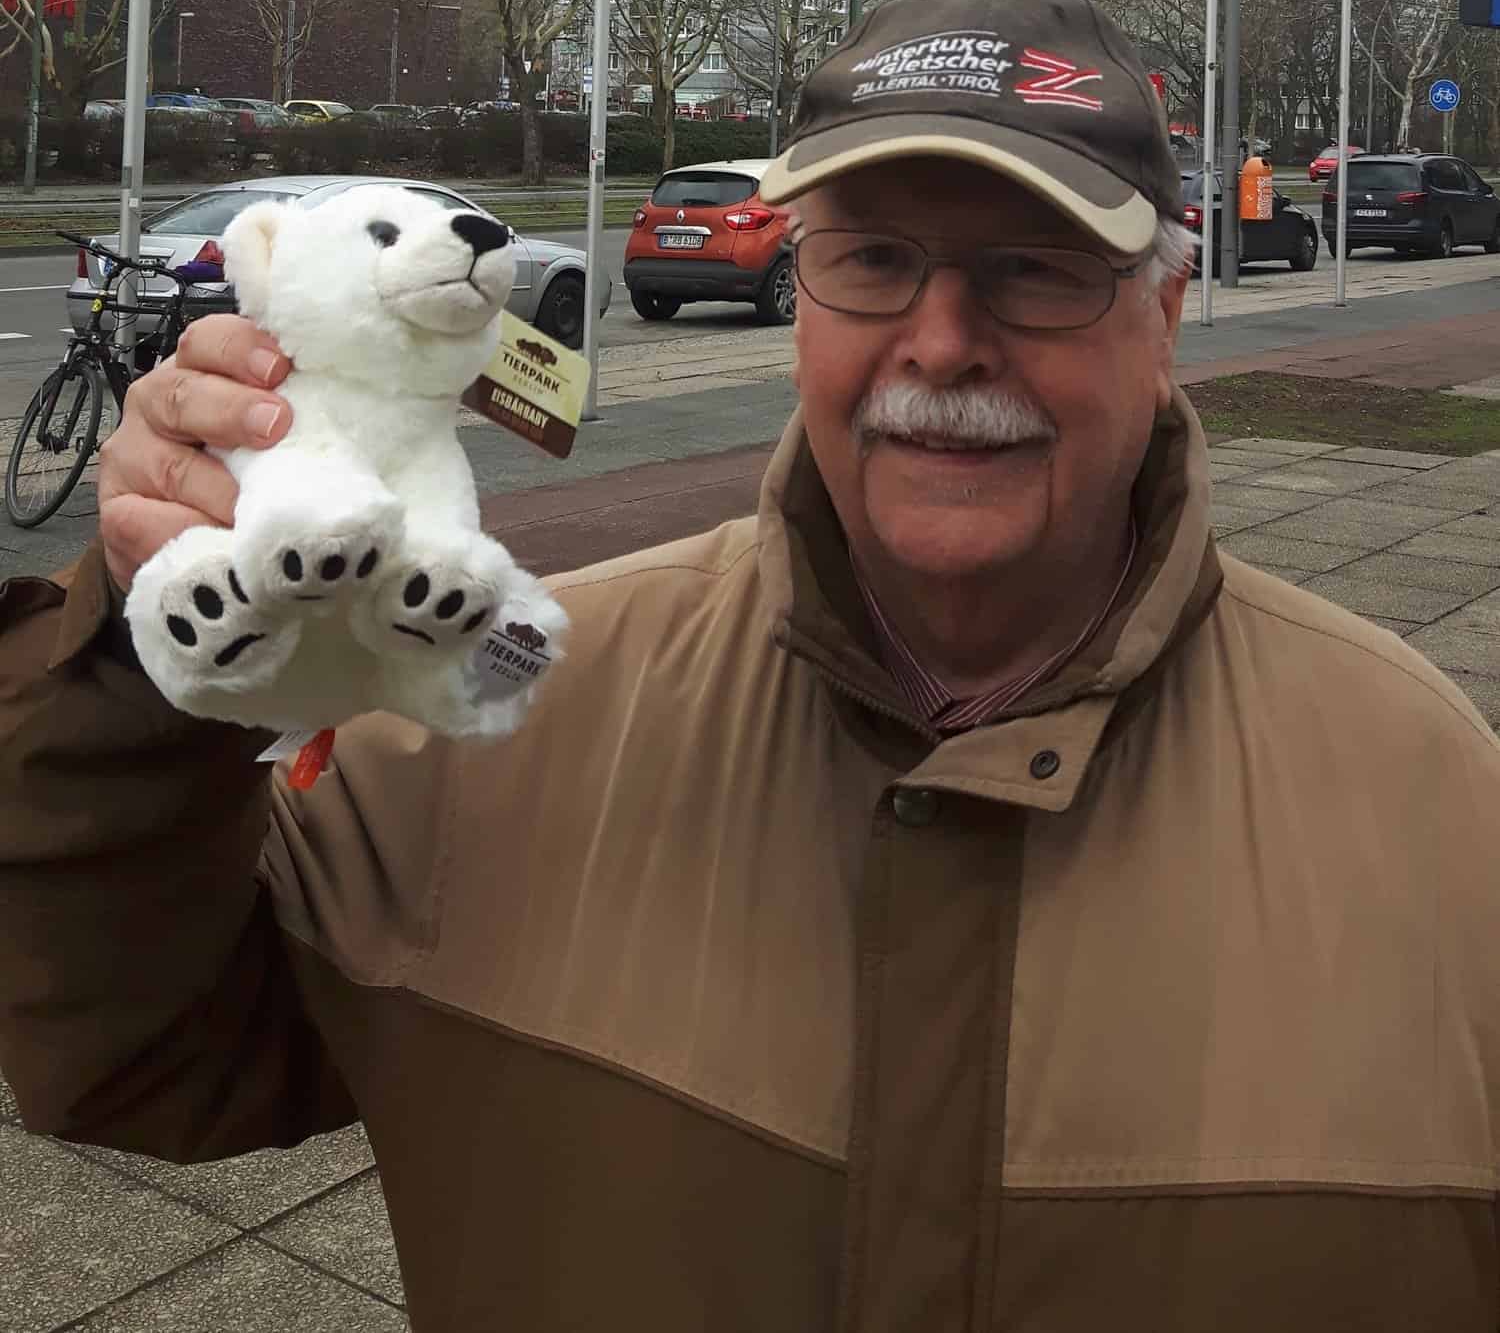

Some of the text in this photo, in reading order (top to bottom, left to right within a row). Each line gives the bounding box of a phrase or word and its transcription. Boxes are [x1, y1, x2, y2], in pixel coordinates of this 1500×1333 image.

[877, 50, 1013, 76] Gletscher
[851, 74, 1001, 97] ZILLERTAL TIROL
[503, 352, 560, 394] TIERPARK
[484, 638, 541, 677] TIERPARK
